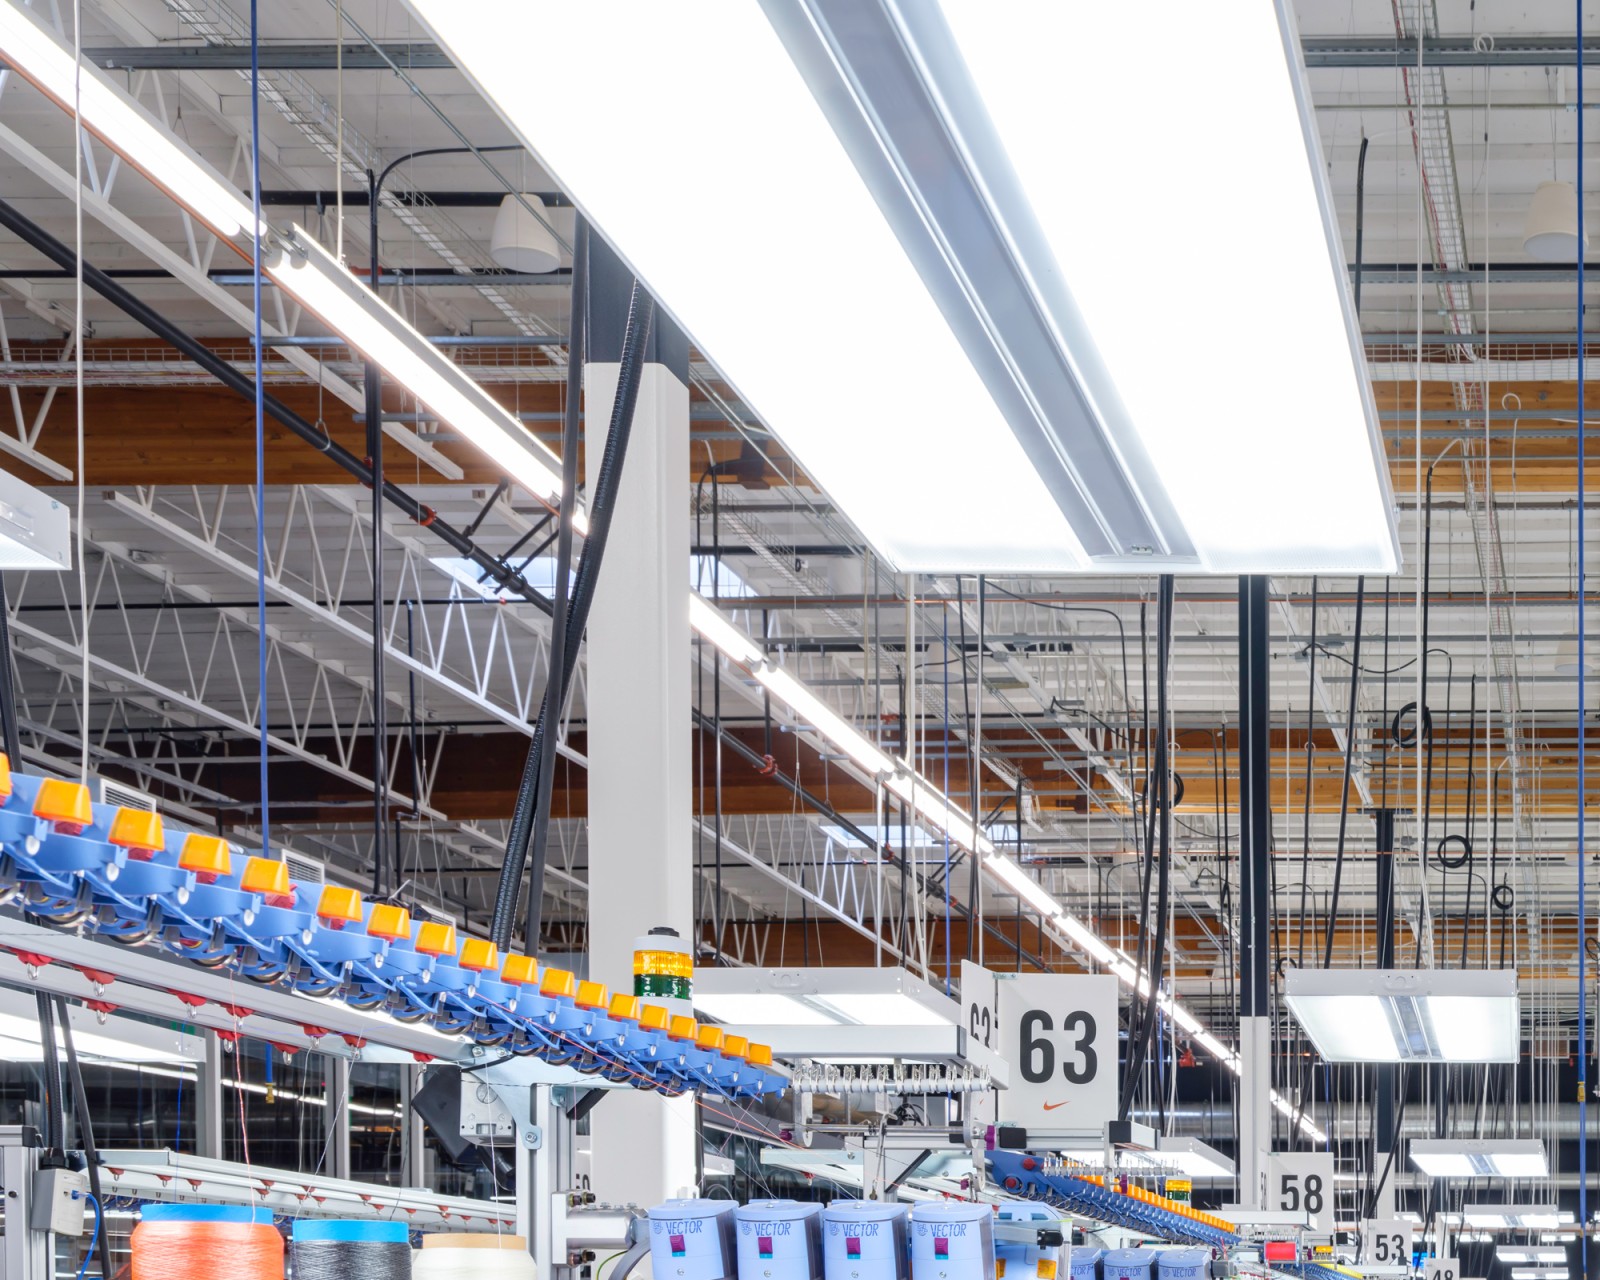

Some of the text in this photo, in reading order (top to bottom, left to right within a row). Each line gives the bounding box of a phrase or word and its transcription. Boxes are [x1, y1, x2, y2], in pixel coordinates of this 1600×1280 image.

[1020, 1009, 1098, 1085] 63
[1280, 1174, 1323, 1214] 58
[665, 1220, 703, 1235] VECTOR
[754, 1222, 791, 1236] VECTOR
[842, 1223, 879, 1236] VECTOR
[931, 1223, 967, 1237] VECTOR
[1375, 1233, 1405, 1261] 53
[1117, 1267, 1142, 1277] VECTOR
[1172, 1268, 1197, 1278] VECTOR
